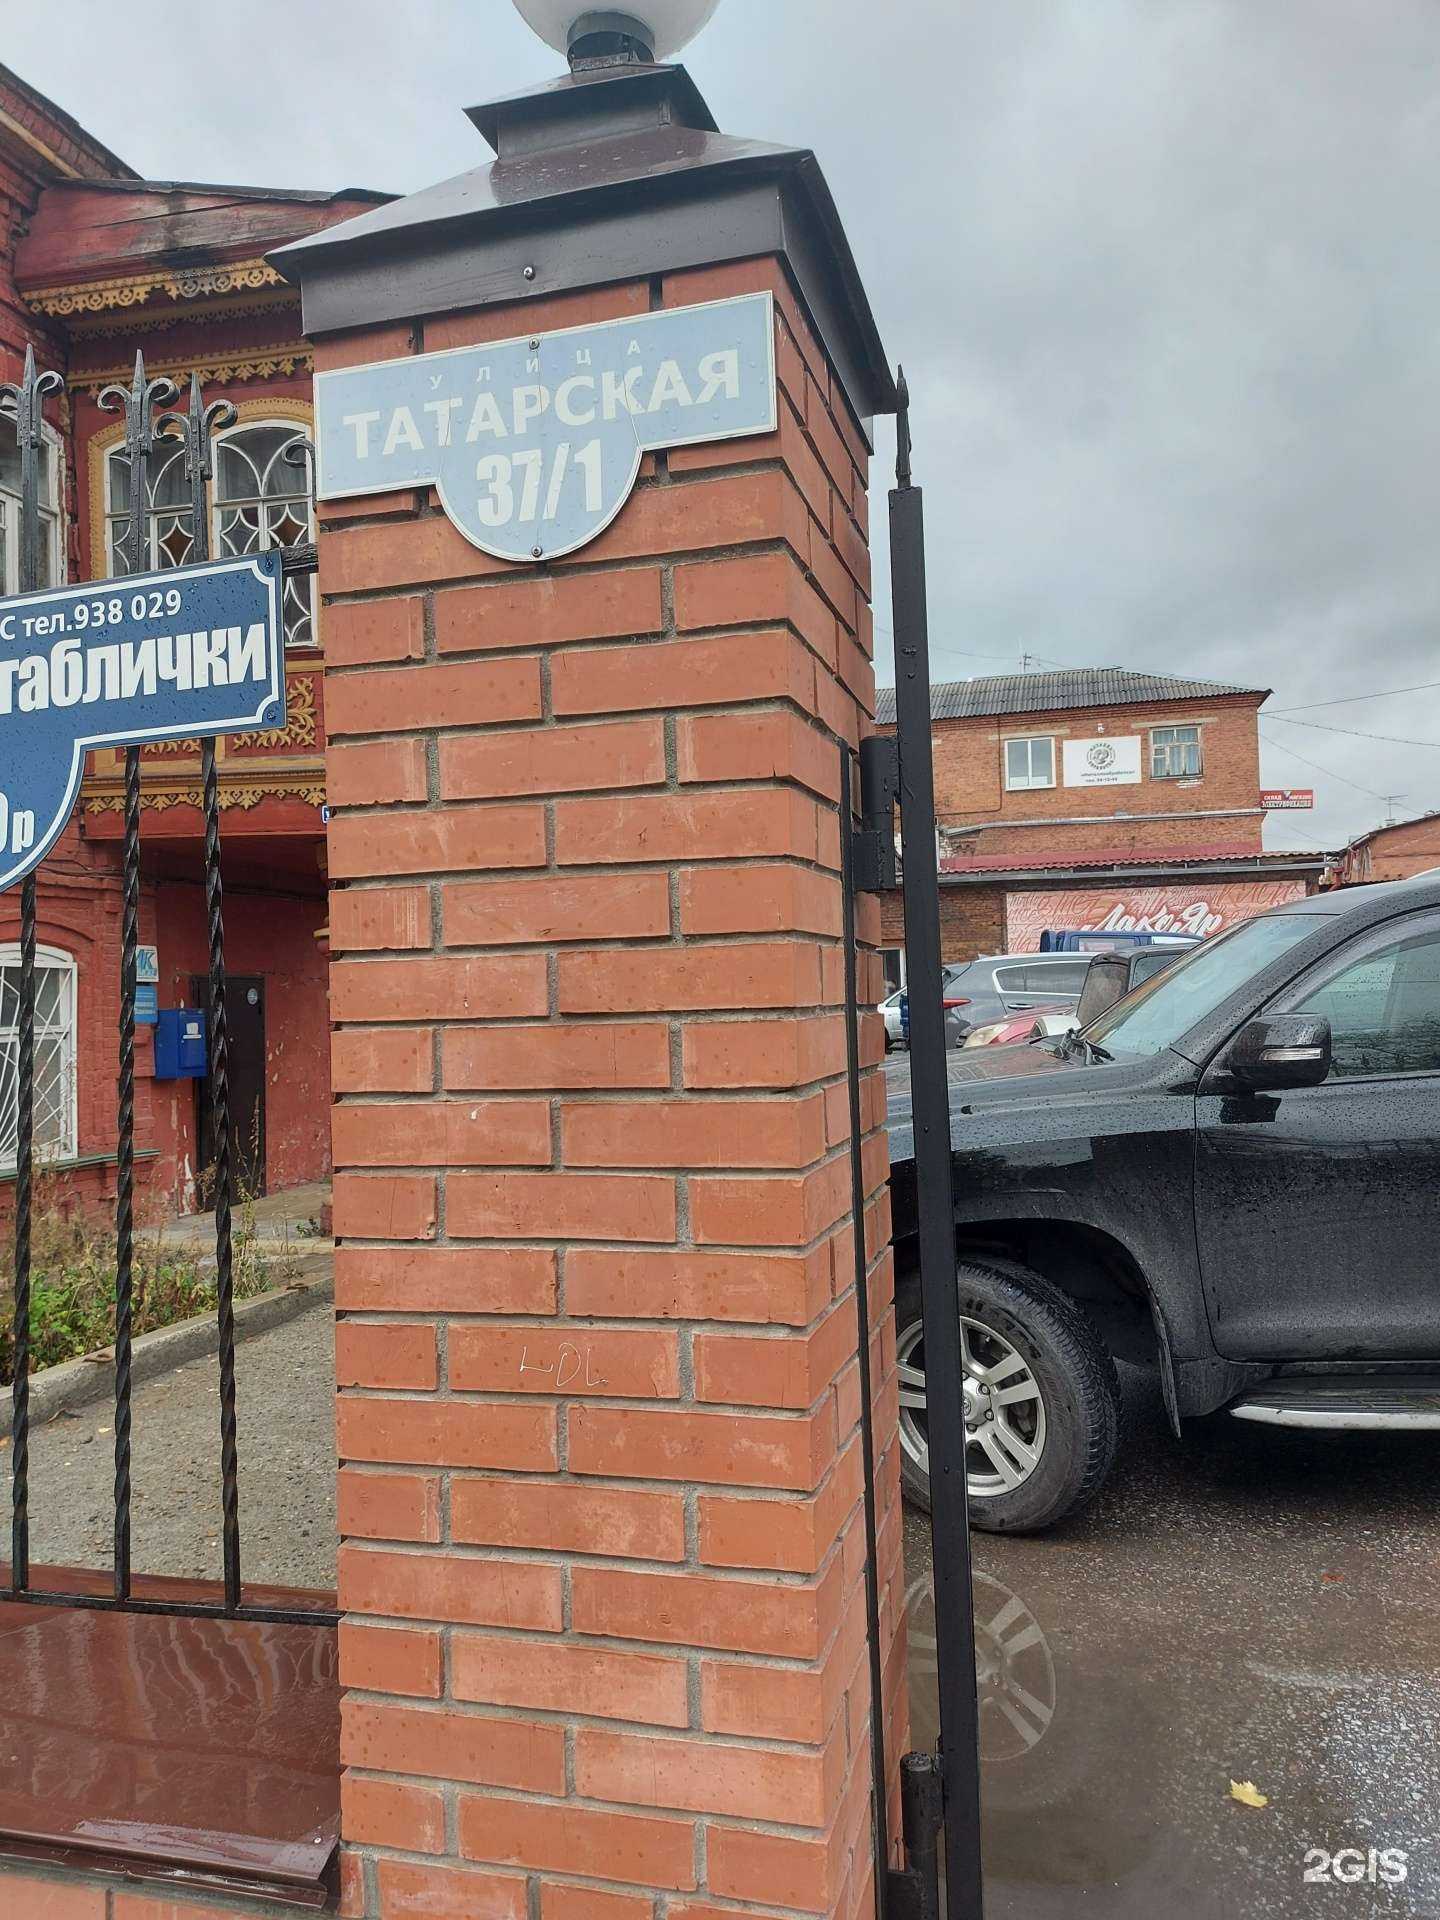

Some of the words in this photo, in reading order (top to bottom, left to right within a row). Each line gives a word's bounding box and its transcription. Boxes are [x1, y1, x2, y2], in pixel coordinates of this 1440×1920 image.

[429, 339, 641, 391] УЛИЦА
[343, 349, 739, 459] ТАТАРСКАЯ
[476, 439, 603, 528] 37/1
[131, 589, 182, 622] 029
